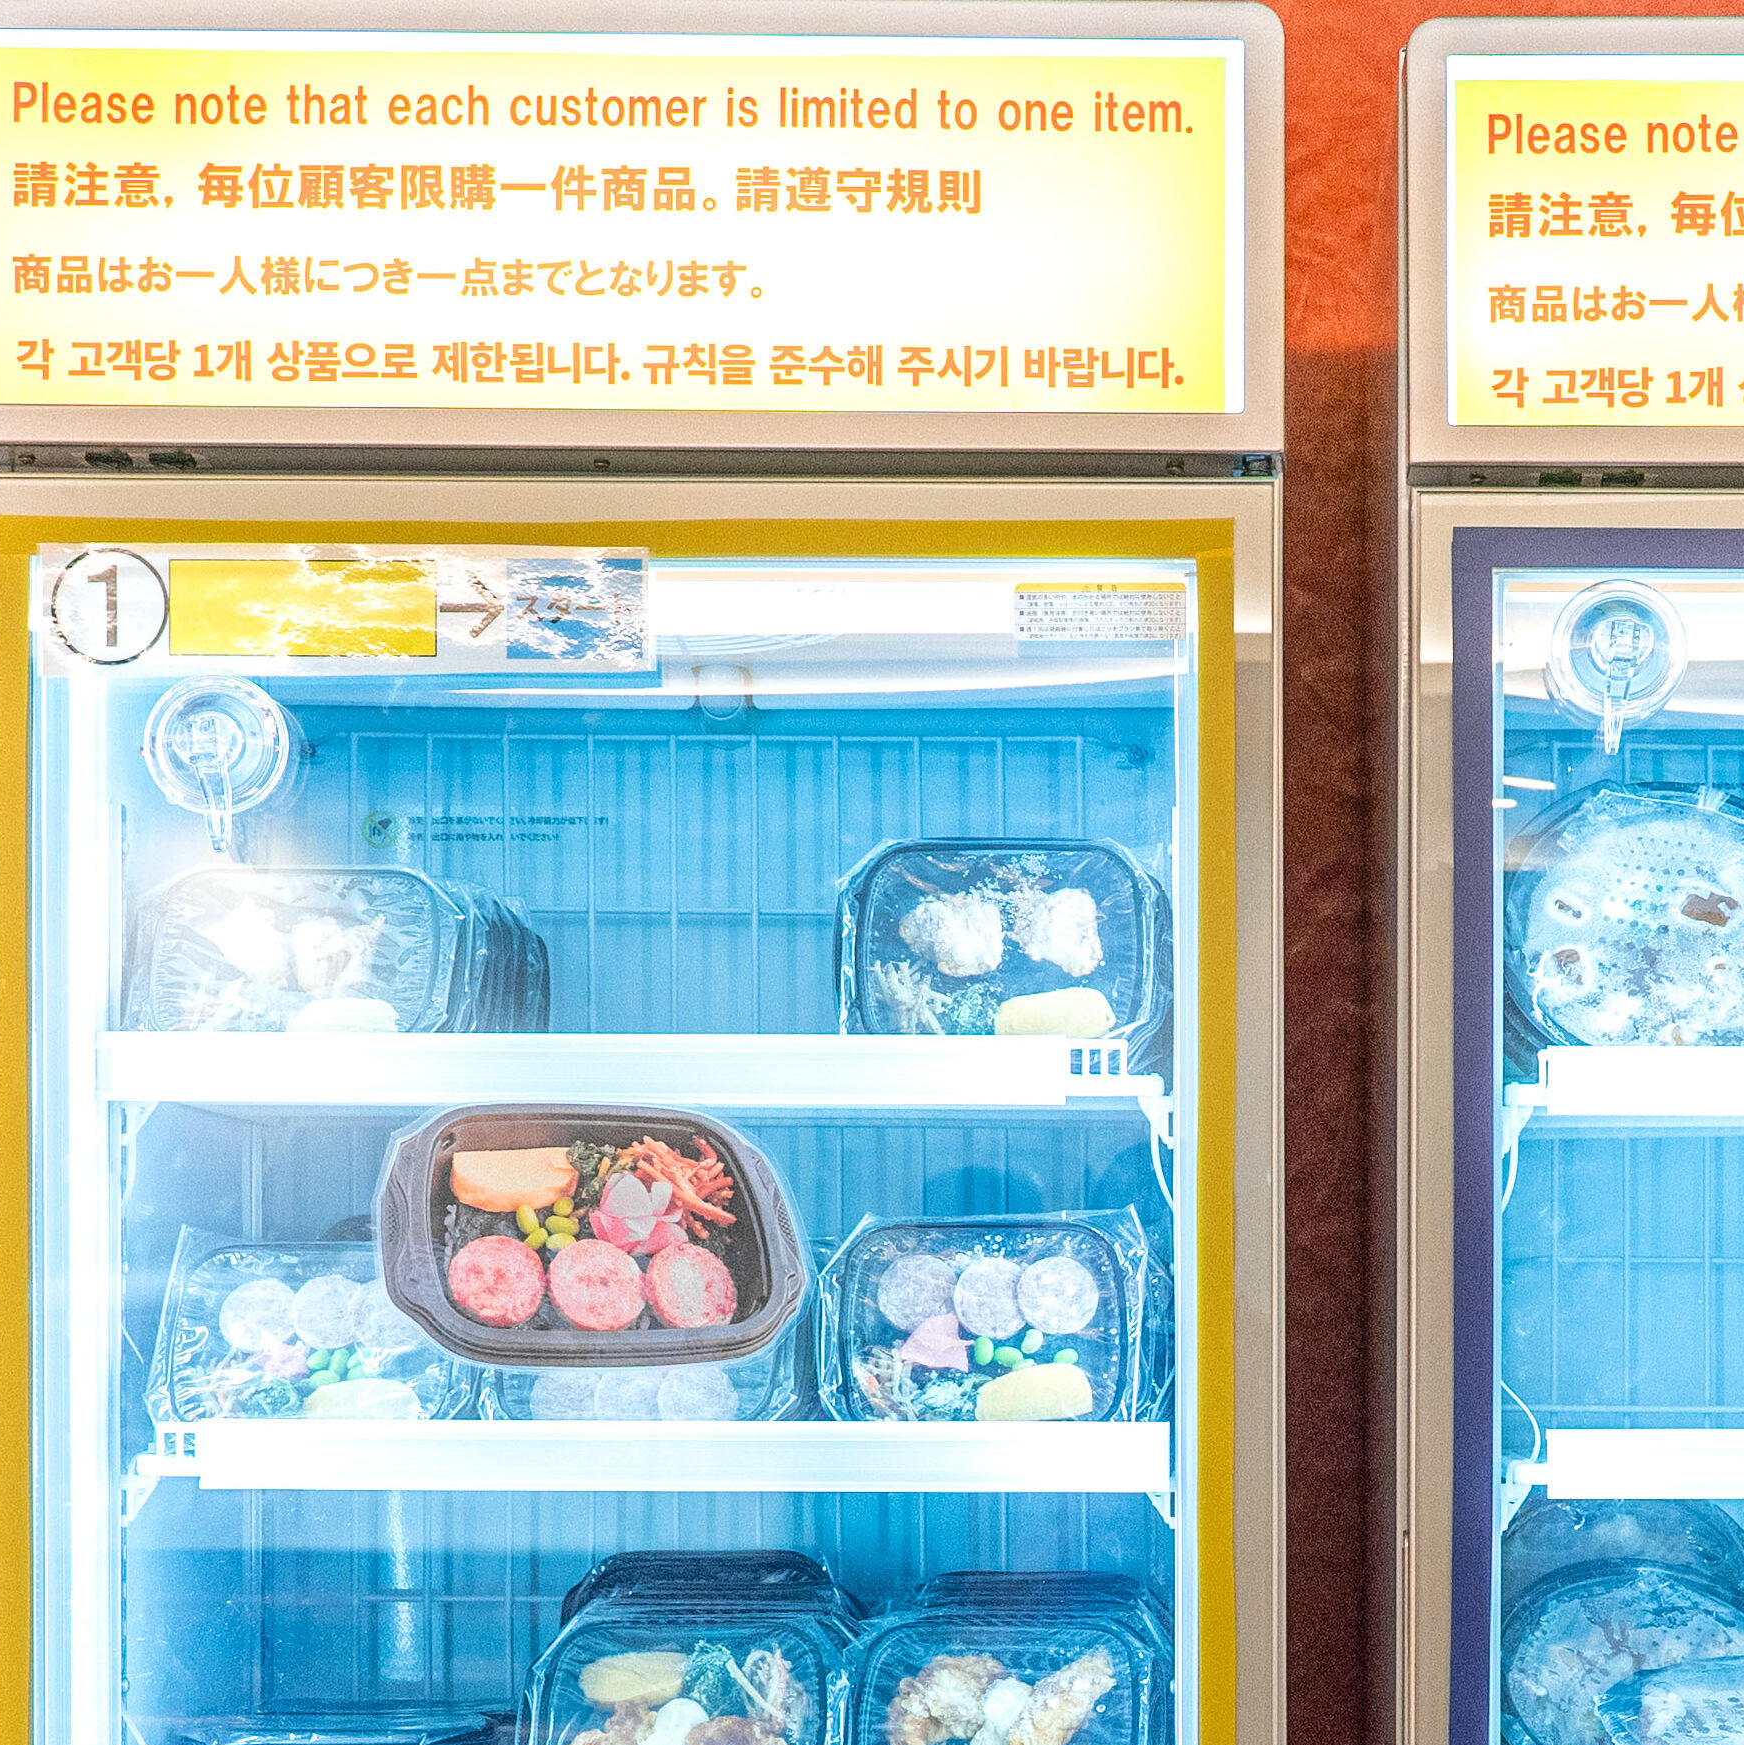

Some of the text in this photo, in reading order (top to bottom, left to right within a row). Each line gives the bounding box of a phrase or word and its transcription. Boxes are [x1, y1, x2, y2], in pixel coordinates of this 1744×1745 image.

[13, 81, 1194, 135] Please note that each customer is limited to one item.
[1487, 113, 1628, 155] Please
[1646, 113, 1739, 155] note
[11, 253, 763, 300] 商品はお一人様につき一点までとなります。
[16, 338, 1185, 390] 각 고객당 1개 상품으로 제한됩니다. 규칙을 준수해 주시기 바랍니다.
[1490, 367, 1530, 410] 각
[1541, 366, 1655, 410] 고객당
[1665, 366, 1724, 409] 1개
